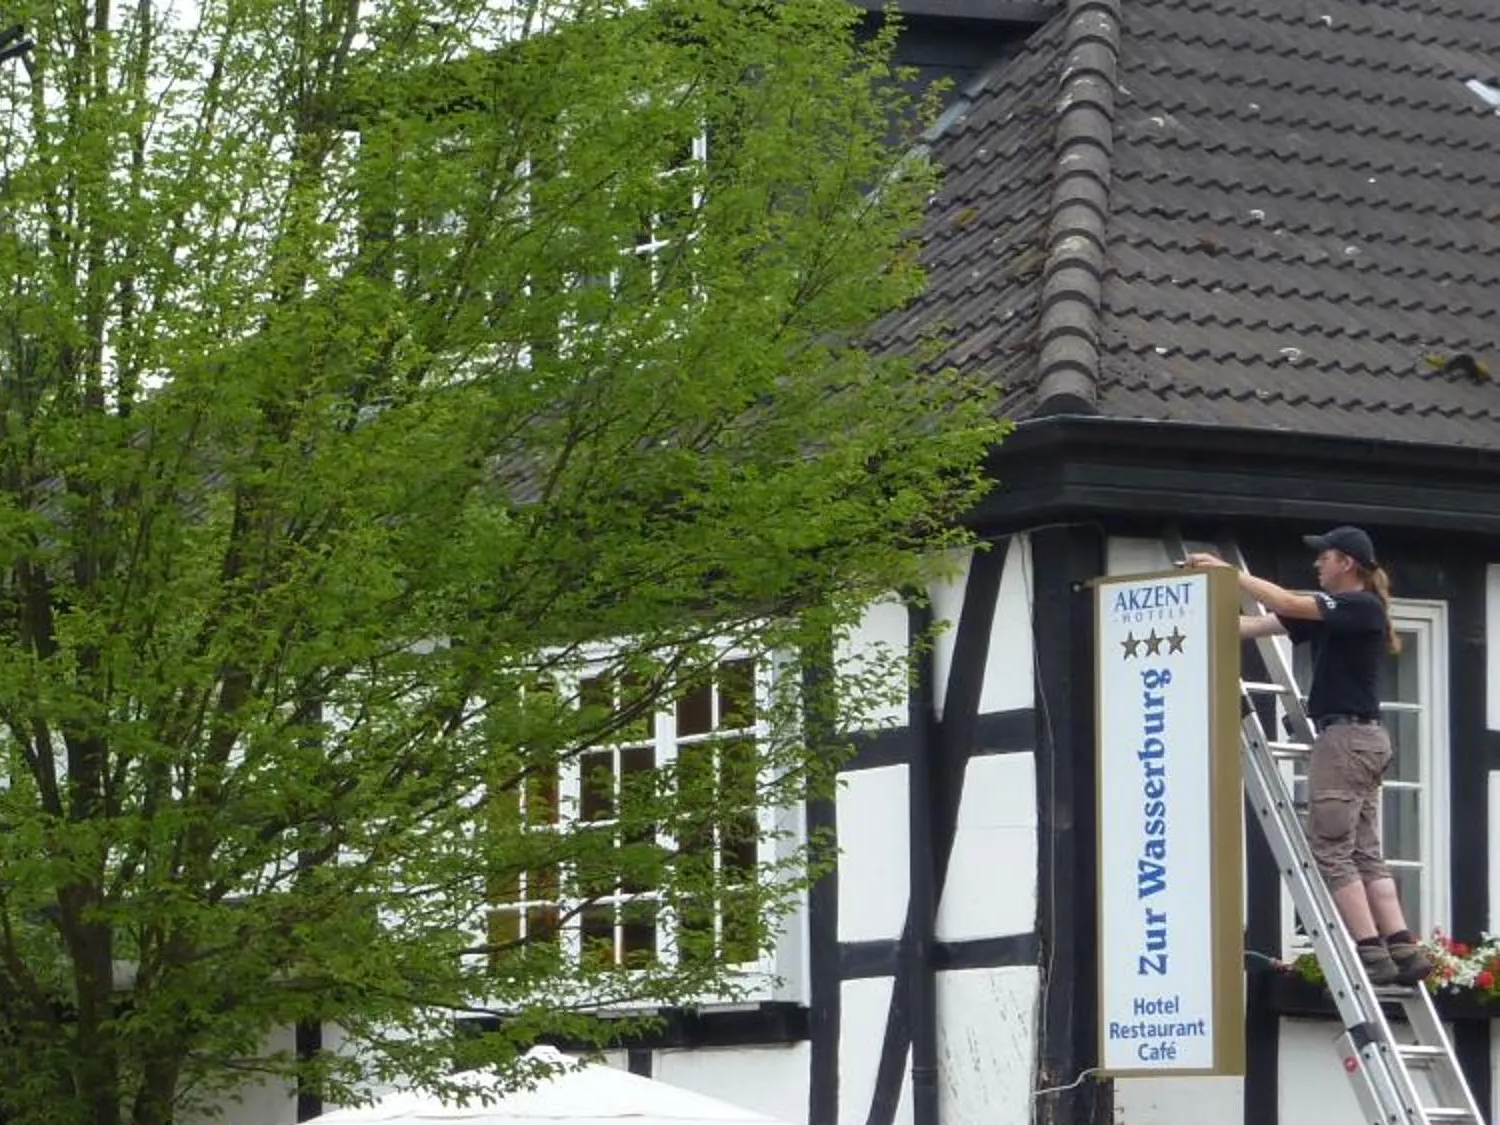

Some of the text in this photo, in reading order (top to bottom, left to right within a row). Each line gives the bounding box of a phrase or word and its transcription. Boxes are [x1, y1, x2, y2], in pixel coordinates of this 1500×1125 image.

[1115, 582, 1193, 612] AKZENT
[1121, 608, 1186, 624] HOTELS
[1137, 668, 1172, 976] Zur Wasserburg
[1133, 995, 1180, 1016] Hotel
[1109, 1017, 1206, 1040] Restaurant
[1137, 1041, 1178, 1062] Café
